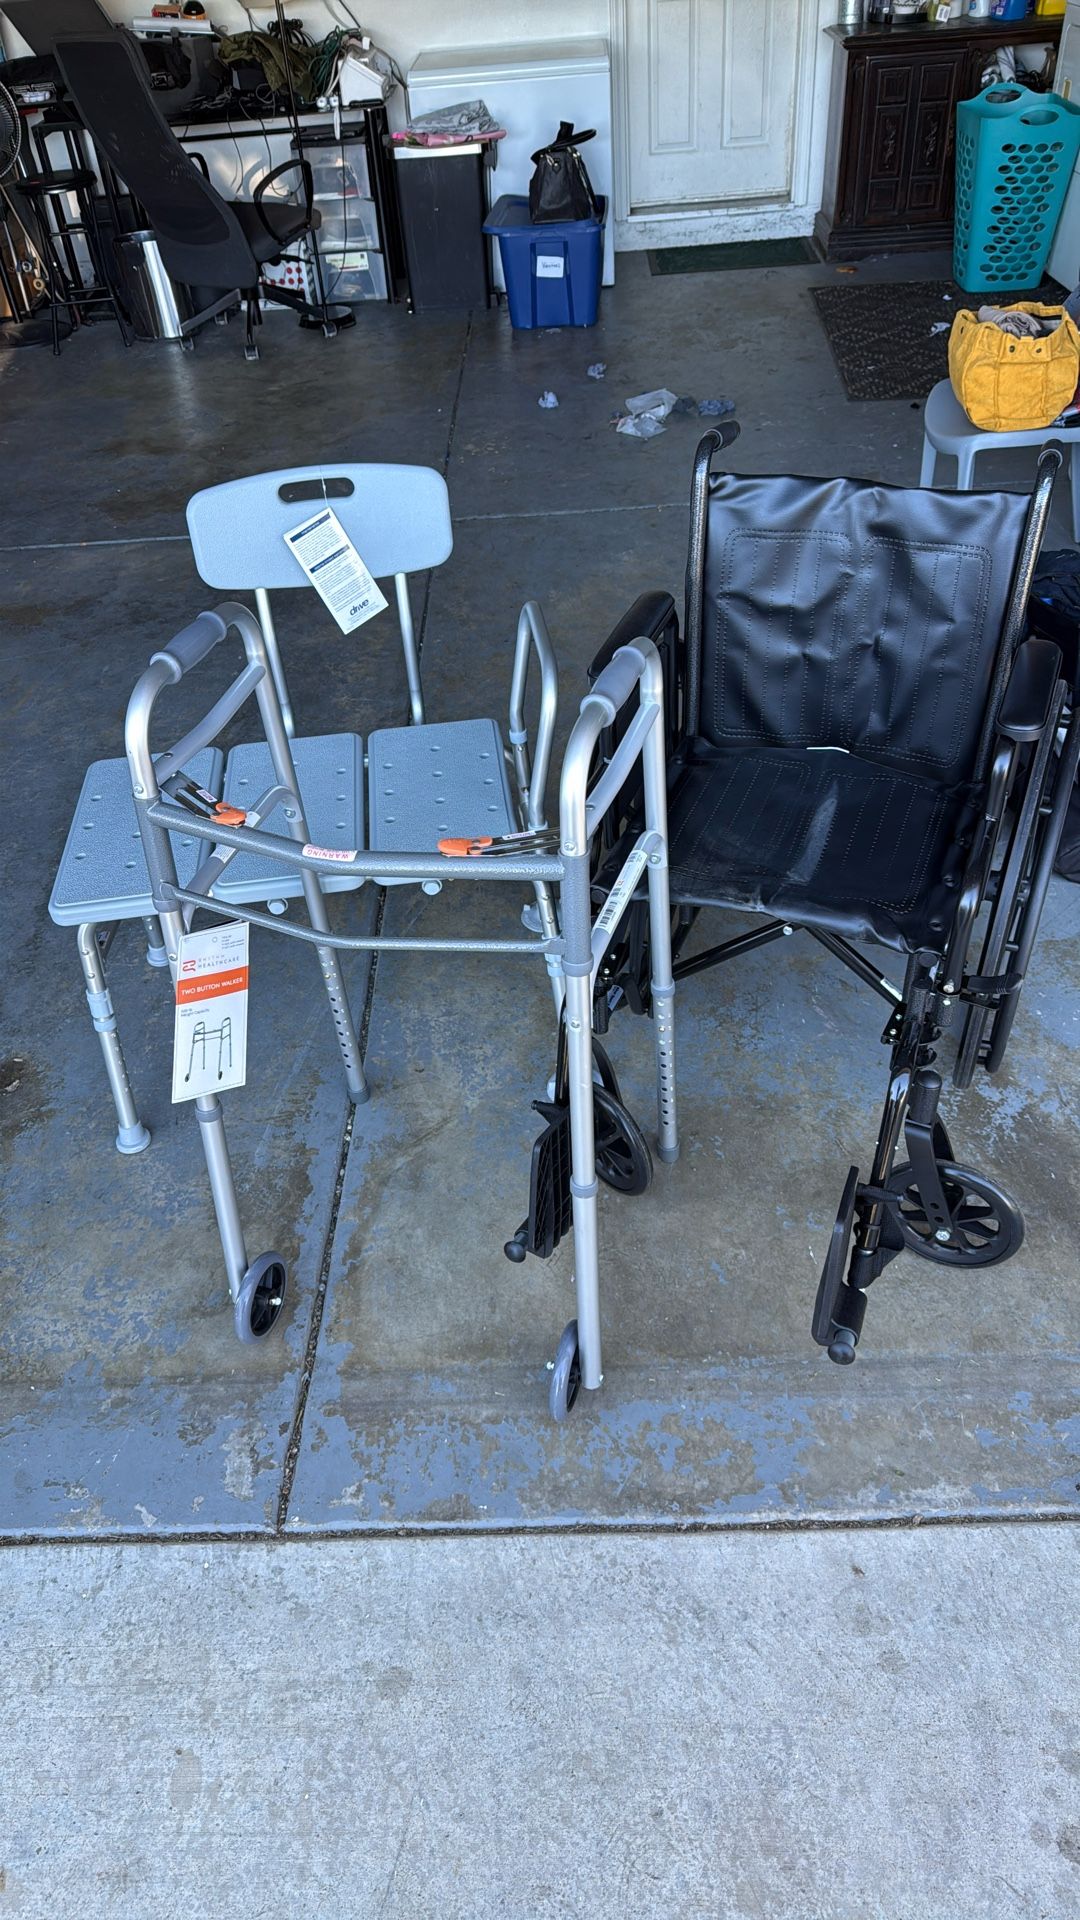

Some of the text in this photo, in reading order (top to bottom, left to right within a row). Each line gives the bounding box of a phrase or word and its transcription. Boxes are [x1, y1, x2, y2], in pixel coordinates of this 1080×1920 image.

[349, 599, 369, 615] drive
[307, 849, 349, 859] WARNING
[198, 956, 240, 968] HEALTHCARE
[181, 976, 243, 995] TWO BUTTON WALKER
